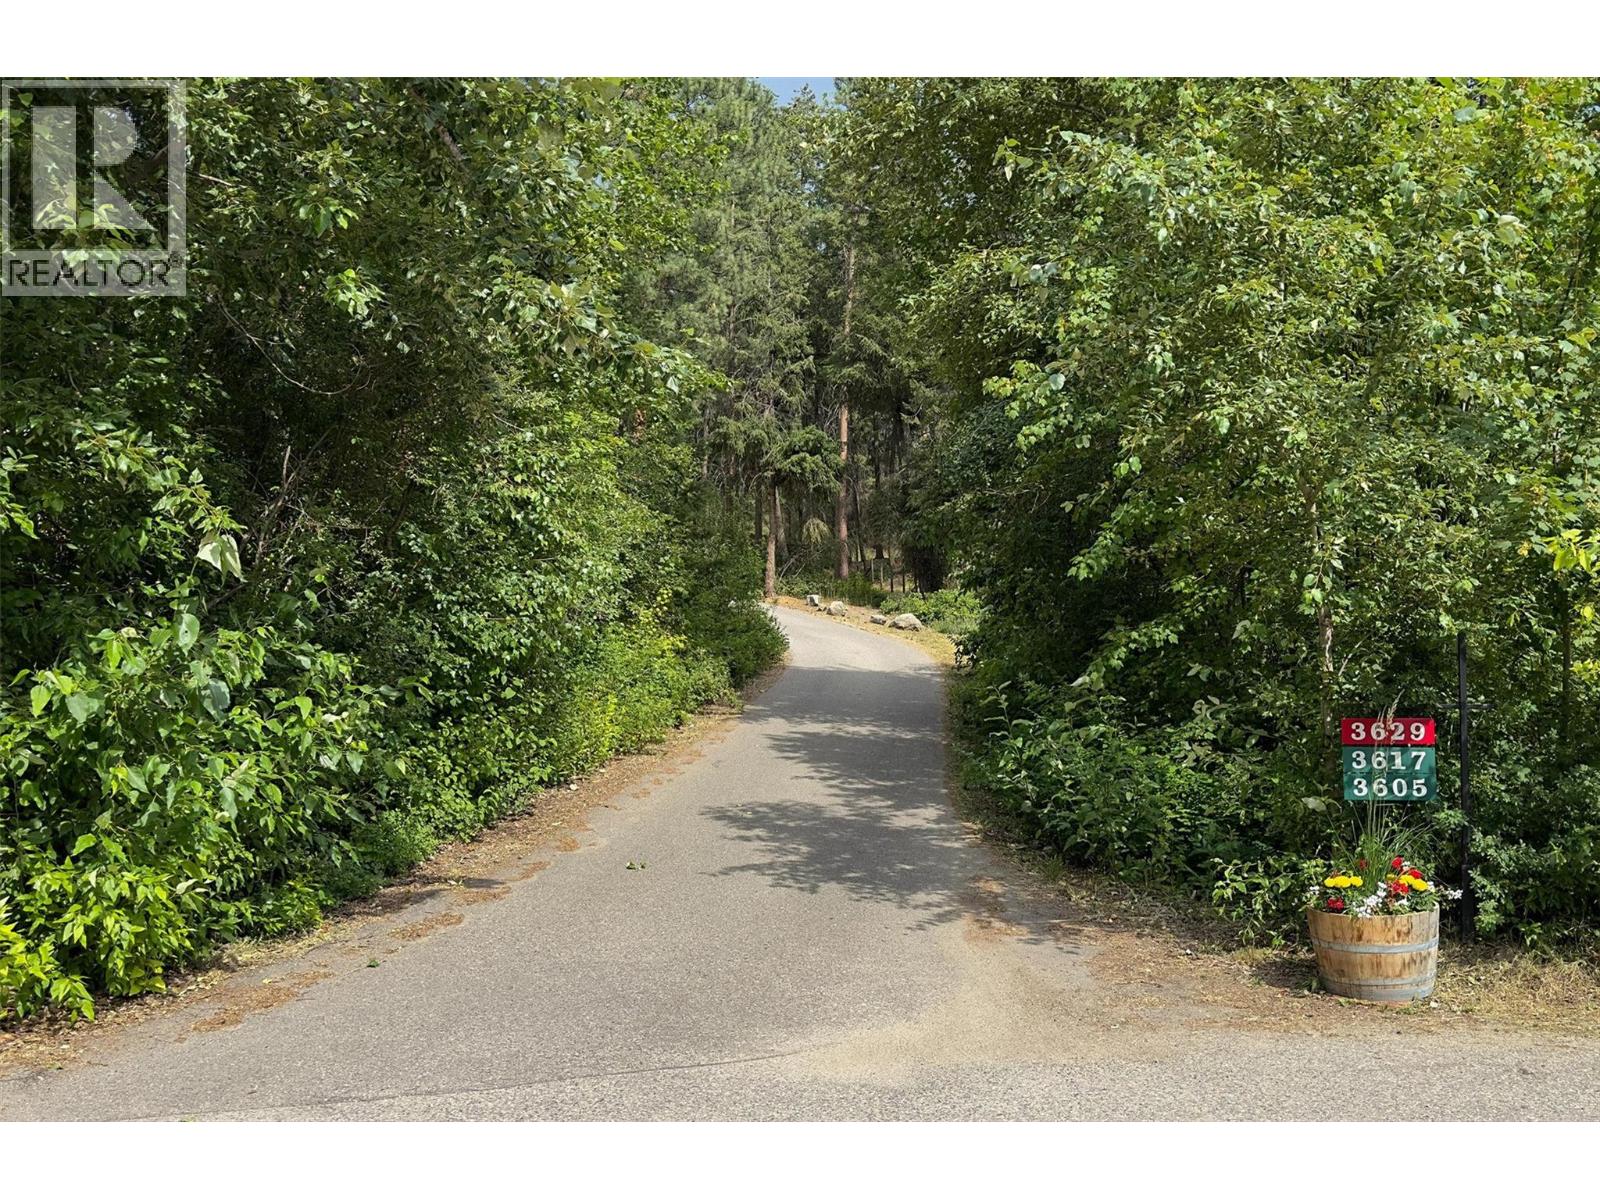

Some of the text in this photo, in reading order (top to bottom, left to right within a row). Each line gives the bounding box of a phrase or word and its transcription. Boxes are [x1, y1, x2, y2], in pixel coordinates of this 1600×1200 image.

[1351, 722, 1426, 741] 3629
[1352, 751, 1426, 770] 3617
[1353, 778, 1428, 797] 3605
